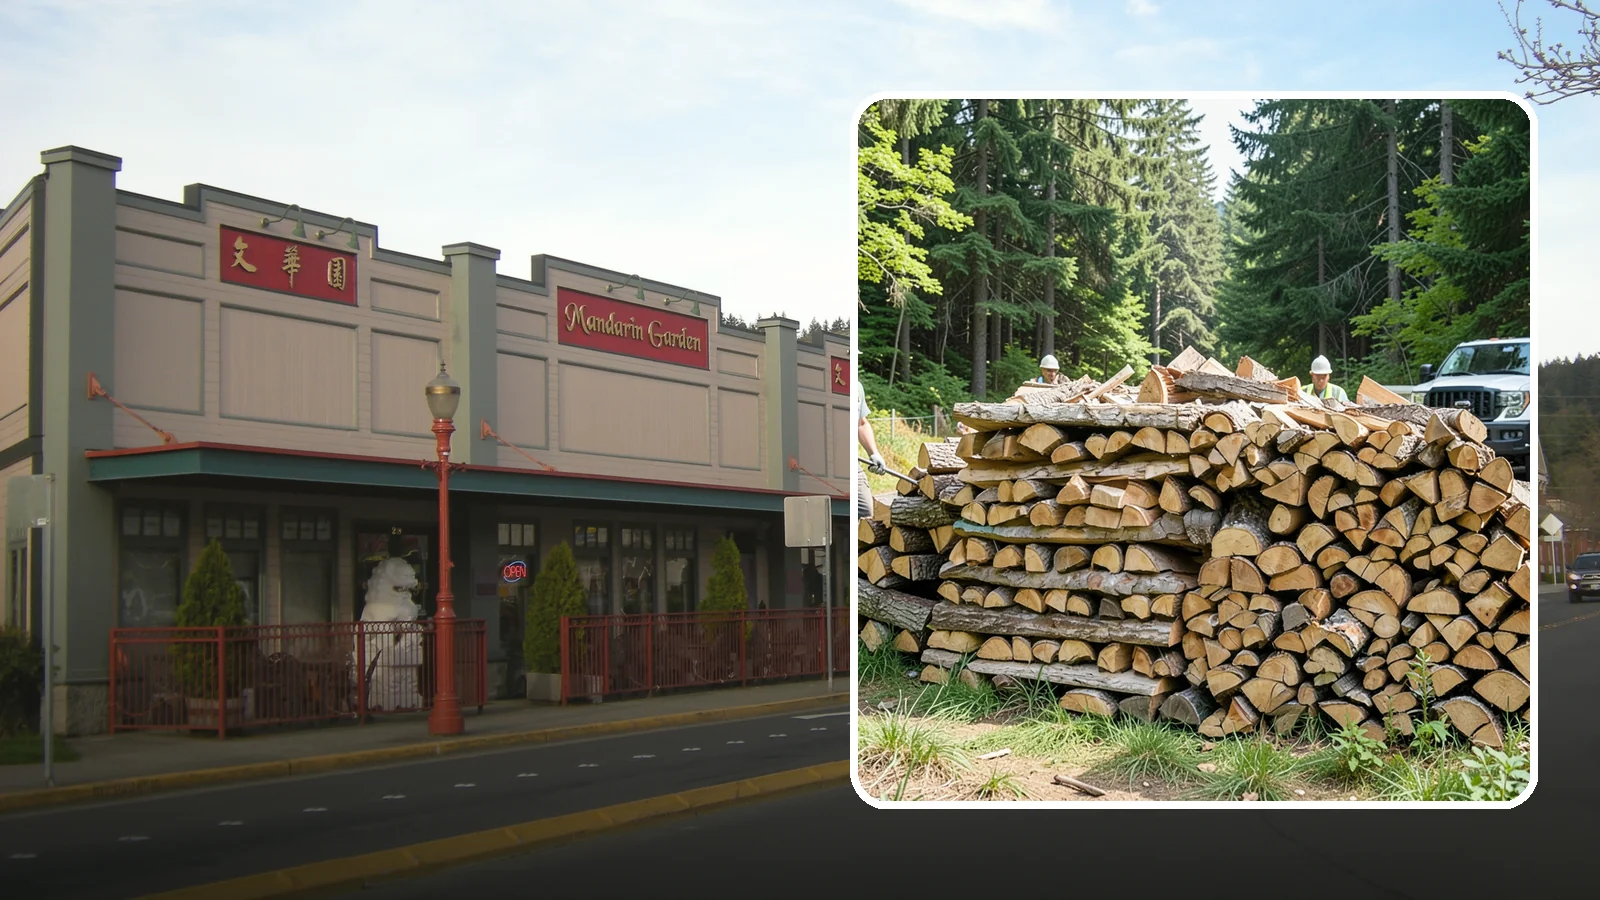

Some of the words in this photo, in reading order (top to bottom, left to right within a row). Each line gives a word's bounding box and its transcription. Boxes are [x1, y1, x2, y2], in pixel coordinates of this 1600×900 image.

[230, 235, 346, 290] 文華園
[564, 302, 643, 340] Mandarin
[647, 320, 701, 352] Garden
[503, 565, 527, 578] OPEN
